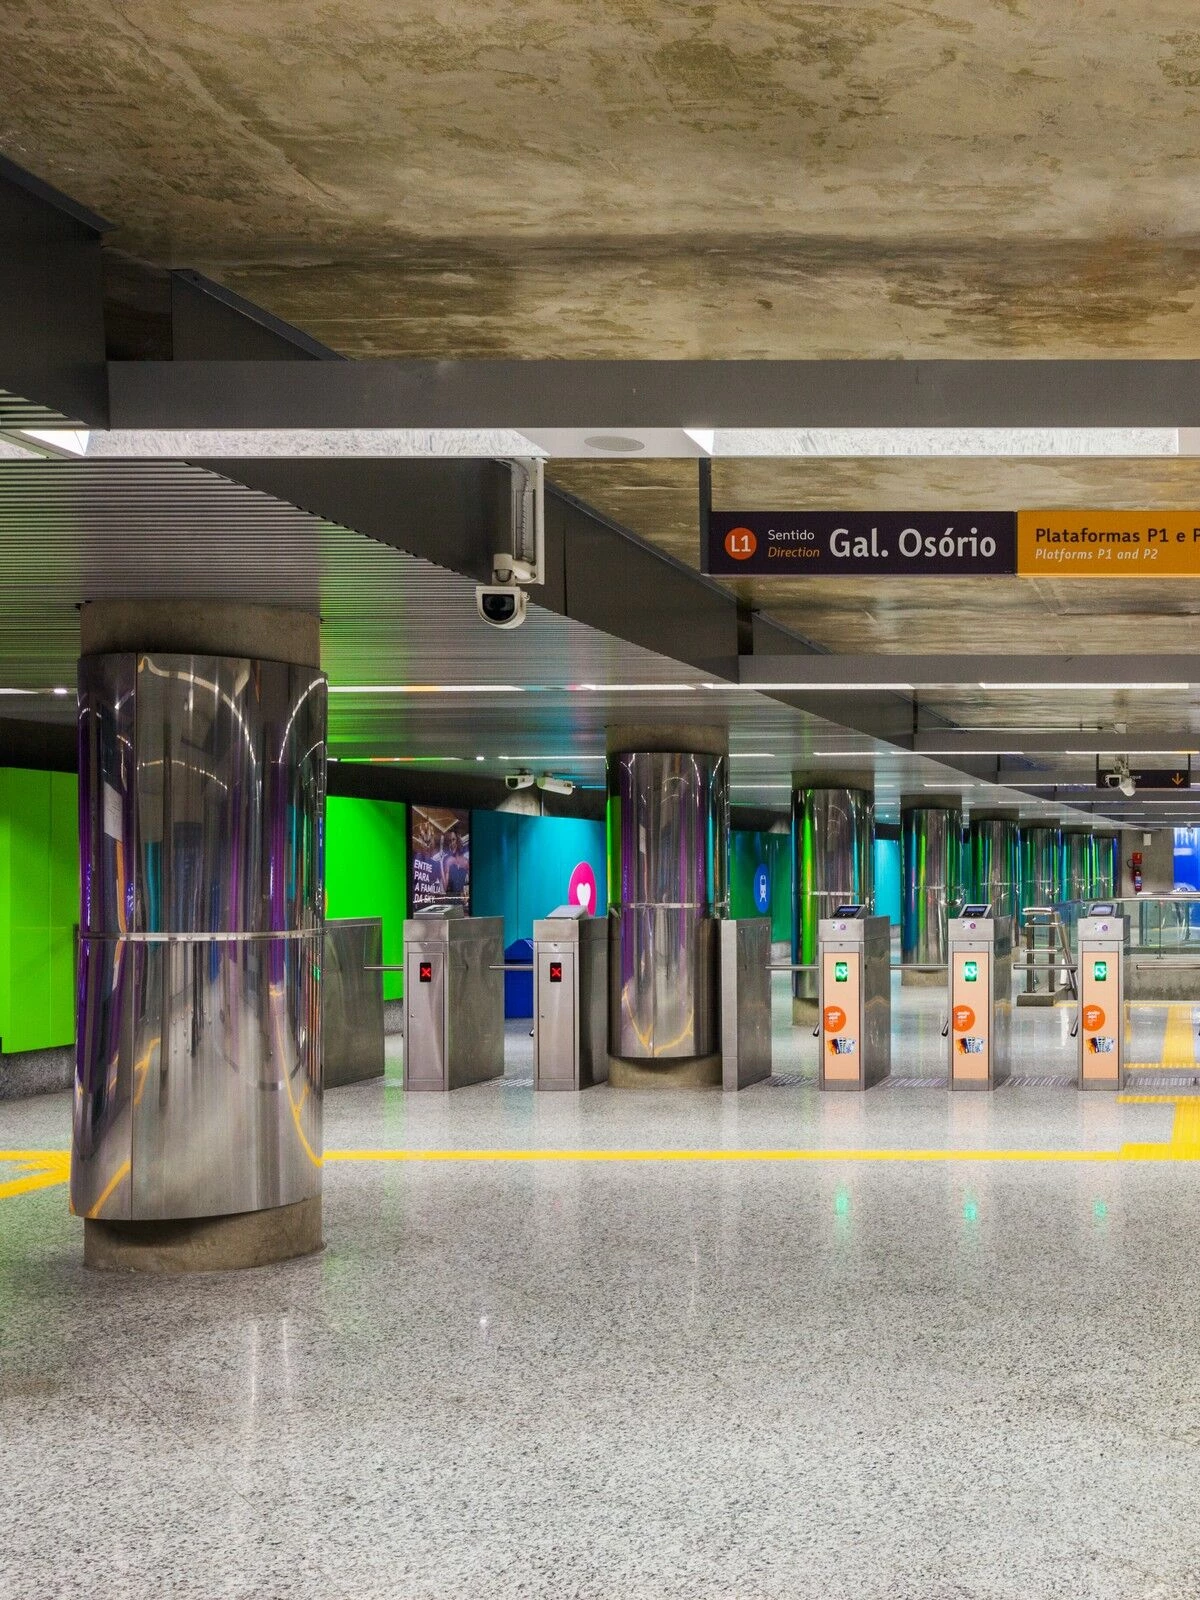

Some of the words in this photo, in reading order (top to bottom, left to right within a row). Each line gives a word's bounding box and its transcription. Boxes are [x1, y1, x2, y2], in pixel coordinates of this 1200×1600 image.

[768, 529, 815, 541] Sentido
[1036, 528, 1140, 543] Plataformas
[1147, 528, 1169, 543] P1
[1176, 532, 1186, 543] e
[731, 535, 752, 552] L1
[829, 528, 888, 558] Gal.
[898, 527, 996, 558] Osório
[768, 546, 820, 558] Direction
[1036, 548, 1093, 562] Platforms
[1098, 549, 1112, 560] P1
[1117, 548, 1139, 560] and
[1143, 549, 1158, 560] P2
[414, 859, 432, 873] ENTRE
[414, 871, 429, 882] PARA
[415, 883, 419, 891] A
